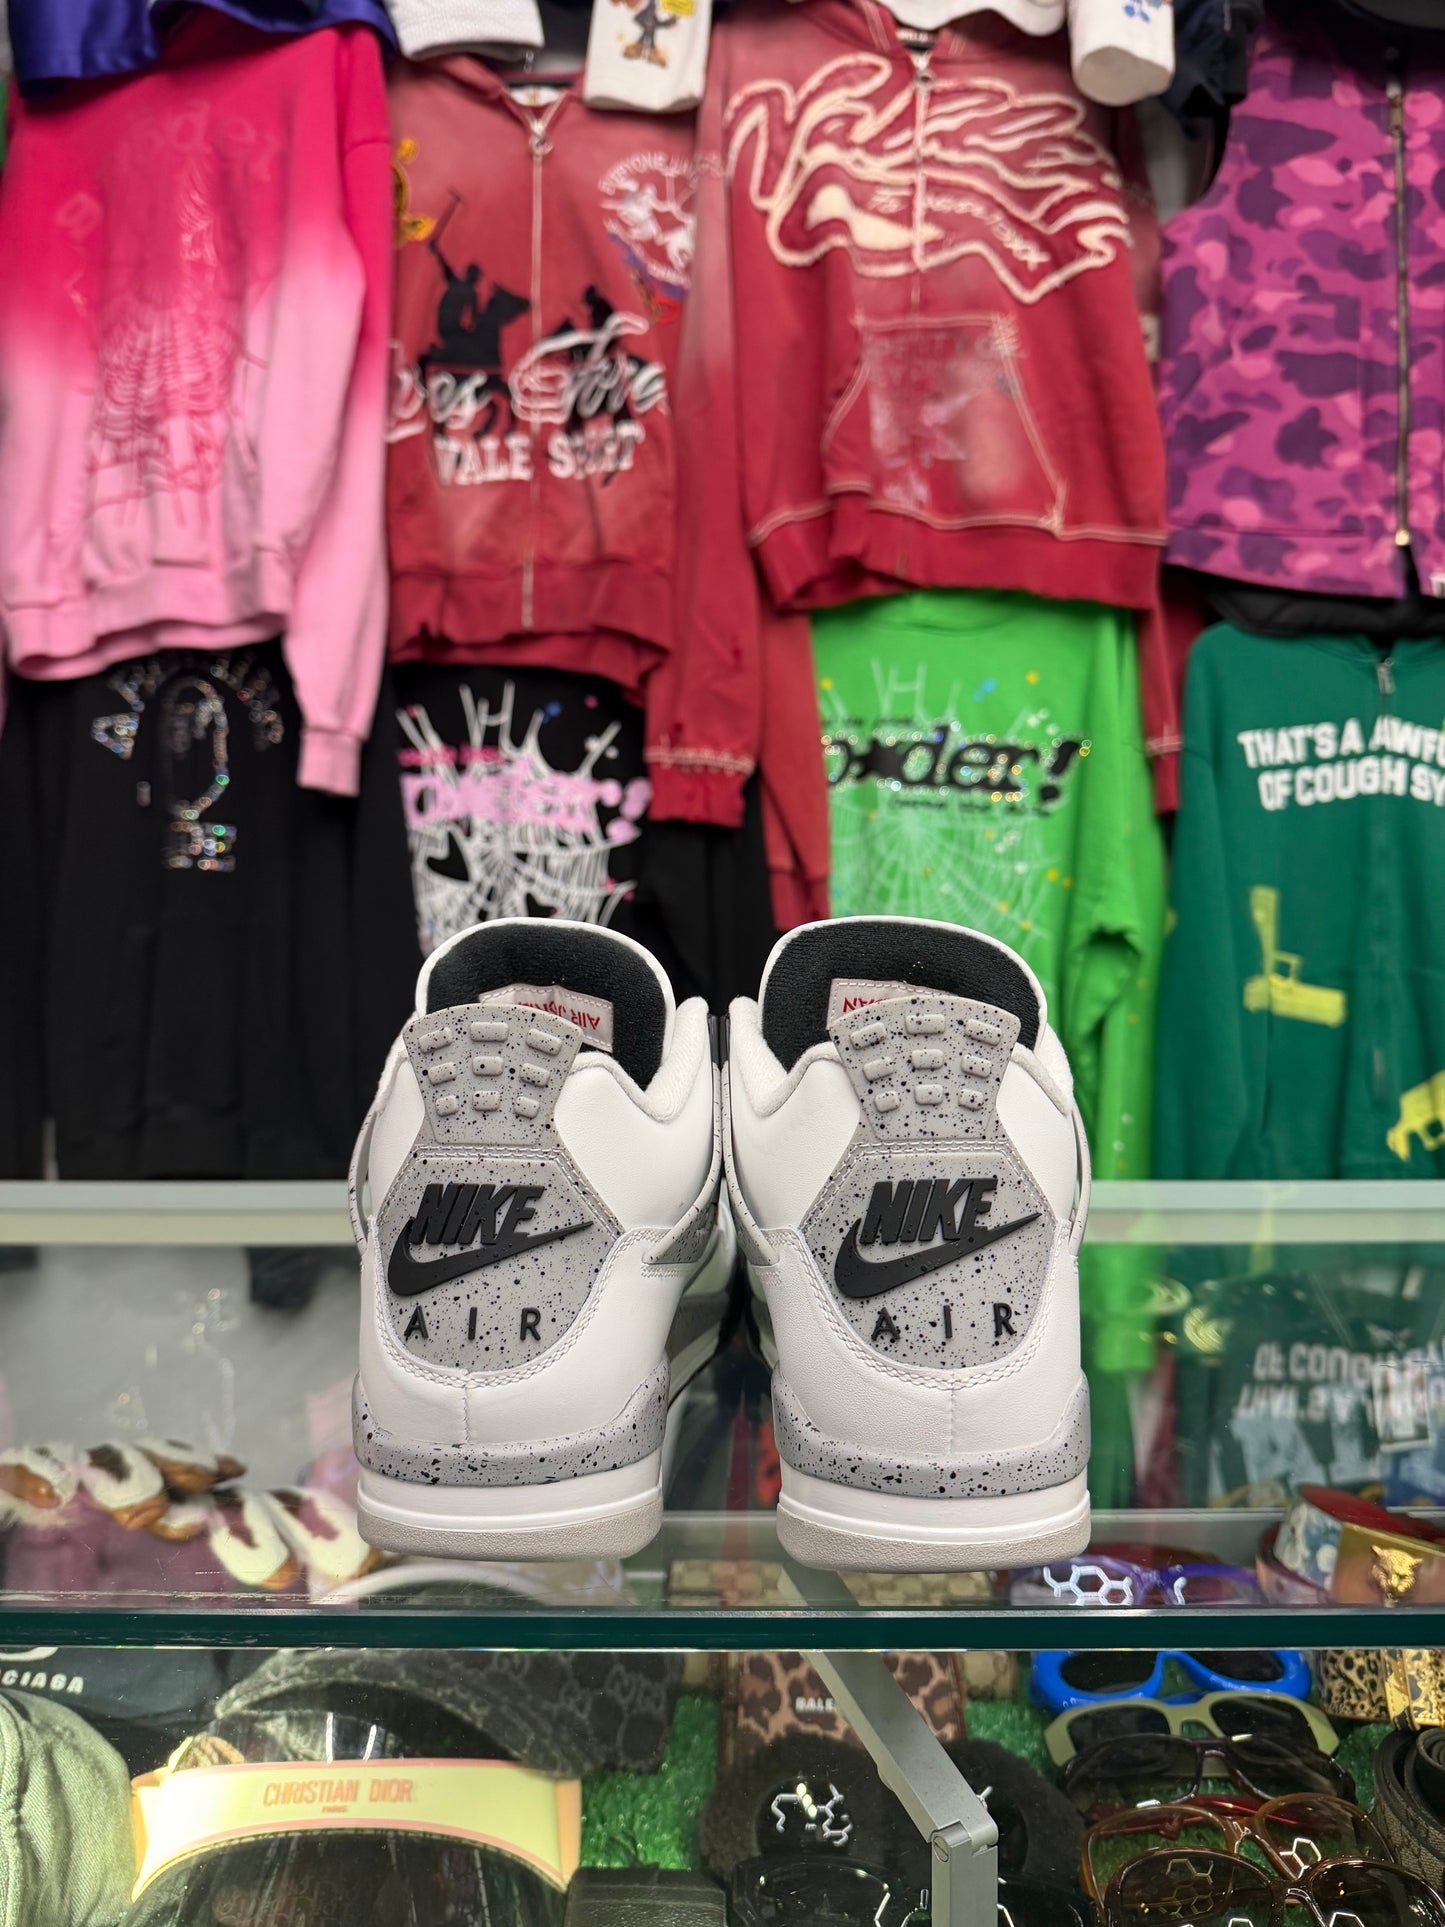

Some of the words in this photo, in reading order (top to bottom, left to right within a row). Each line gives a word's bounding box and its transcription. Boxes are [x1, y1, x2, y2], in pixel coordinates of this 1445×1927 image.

[433, 432, 533, 486] VALE
[1237, 721, 1339, 768] THAT'S
[1340, 717, 1365, 756] A
[1258, 768, 1293, 811] OF
[1295, 755, 1408, 806] COUGH
[570, 1008, 601, 1030] AIR
[409, 1183, 546, 1245] NIKE
[859, 1178, 998, 1244] NIKE
[404, 1305, 541, 1341] AIR
[871, 1302, 1017, 1341] AIR
[0, 1669, 84, 1695] CIAGA
[263, 1779, 359, 1806] CHRISTIAN
[368, 1778, 413, 1803] DIOR
